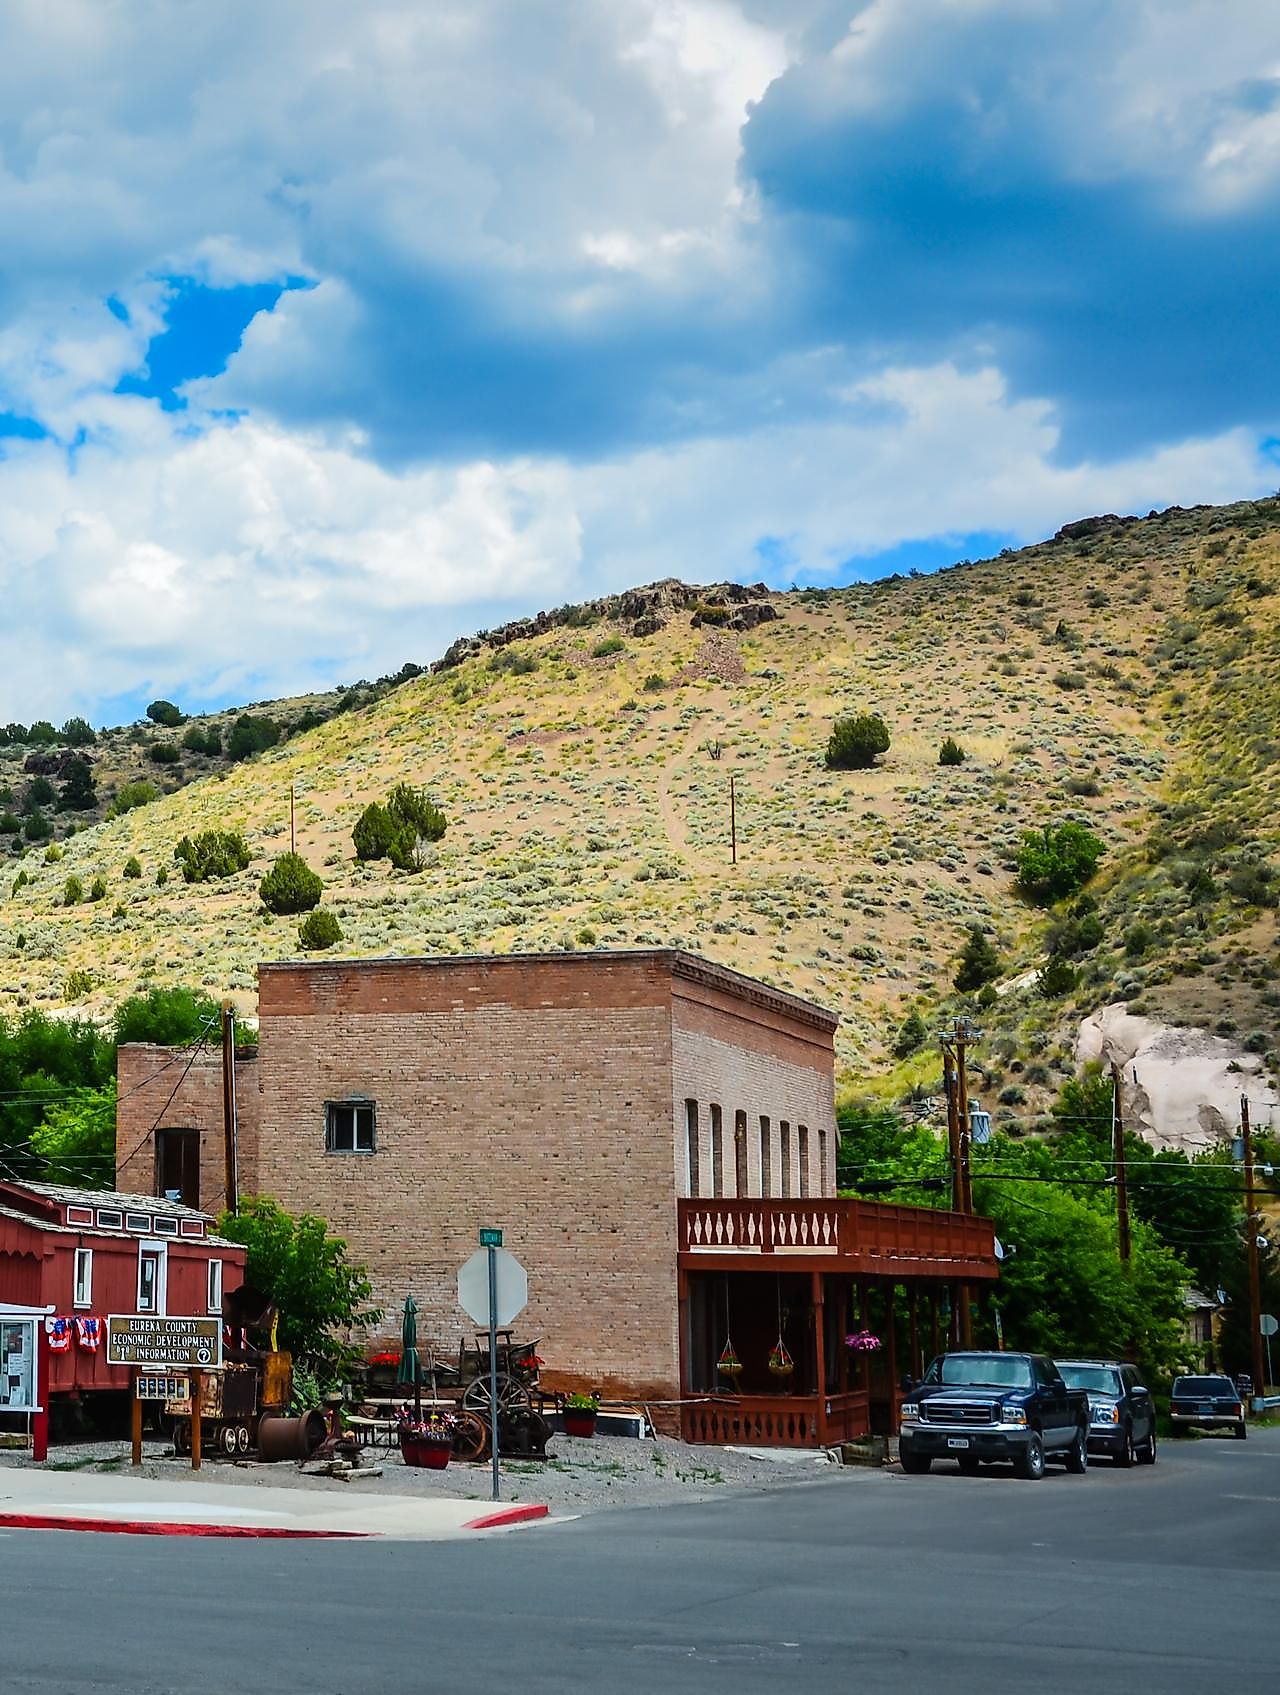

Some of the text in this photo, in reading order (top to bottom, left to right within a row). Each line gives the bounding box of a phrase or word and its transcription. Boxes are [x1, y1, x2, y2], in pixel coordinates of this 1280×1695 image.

[130, 1320, 198, 1334] EUREKA COUNTY
[112, 1334, 215, 1348] ECONOMIC DEVELOPMENT
[136, 1348, 190, 1360] INFORMATION
